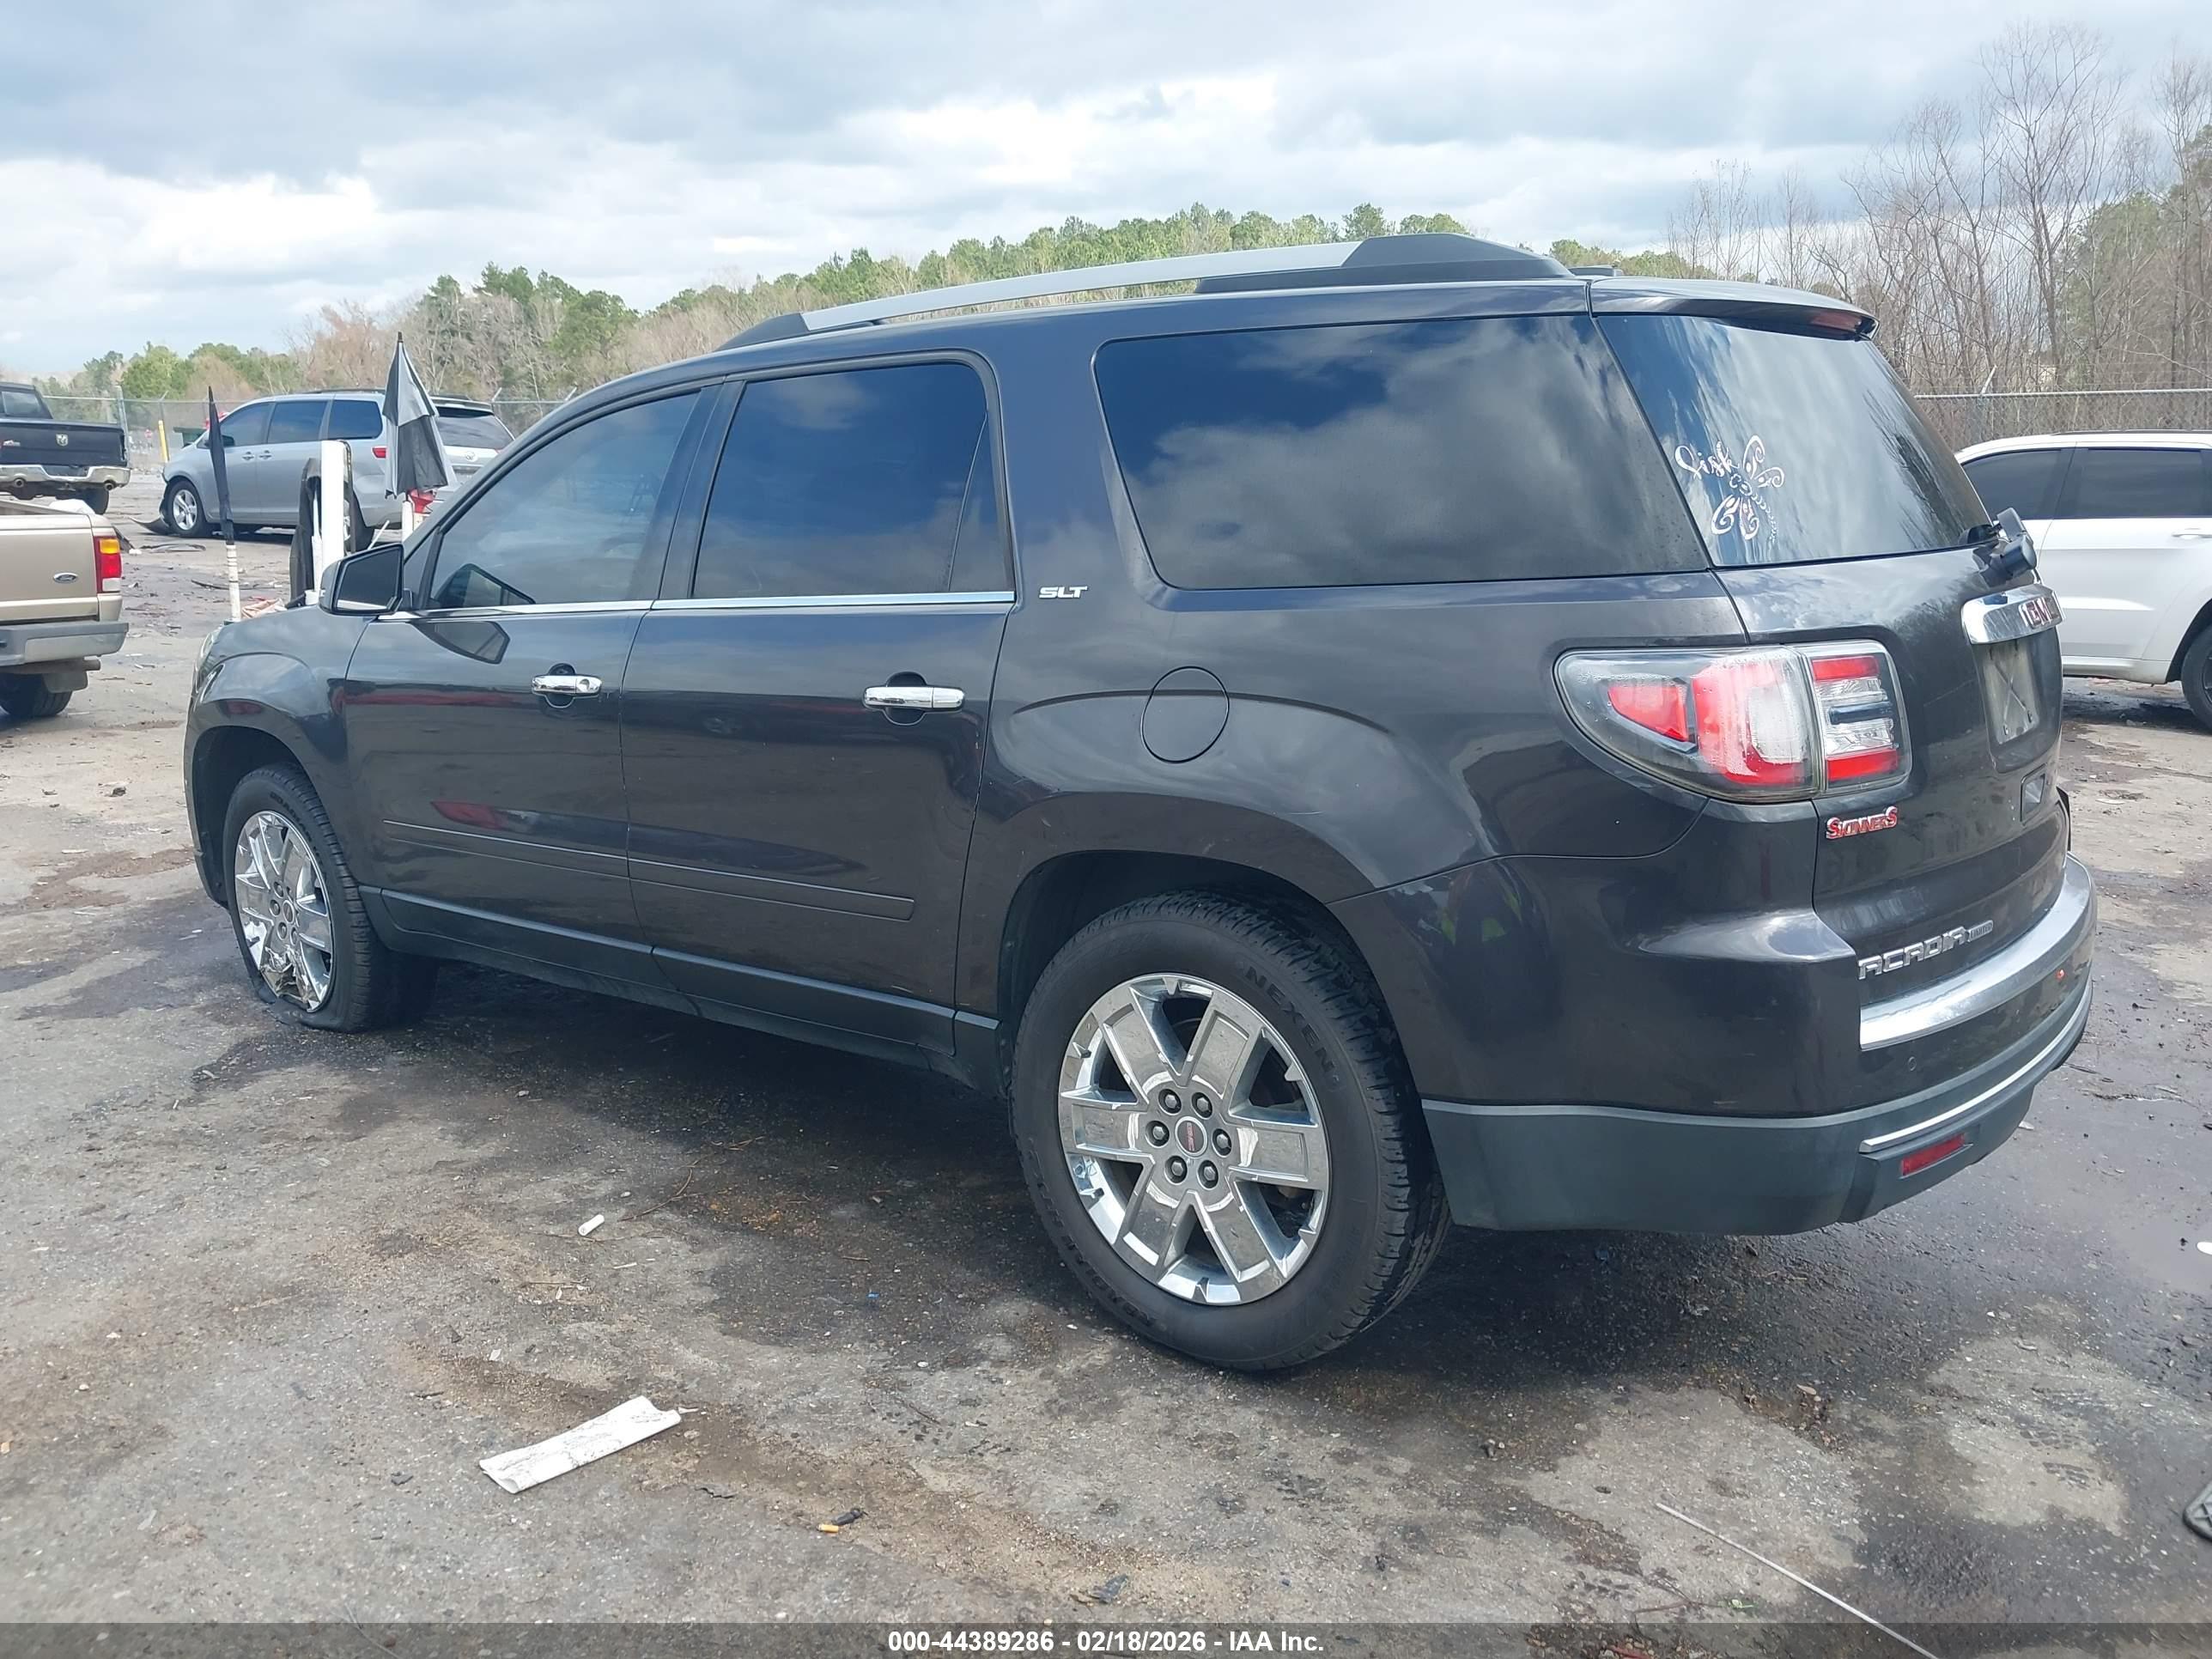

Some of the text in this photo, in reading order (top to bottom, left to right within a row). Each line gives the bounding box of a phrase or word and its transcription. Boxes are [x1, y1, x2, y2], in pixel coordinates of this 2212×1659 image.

[1038, 586, 1088, 599] SLT
[1857, 926, 1966, 981] ACADIA
[1244, 965, 1335, 1073] NEXEN
